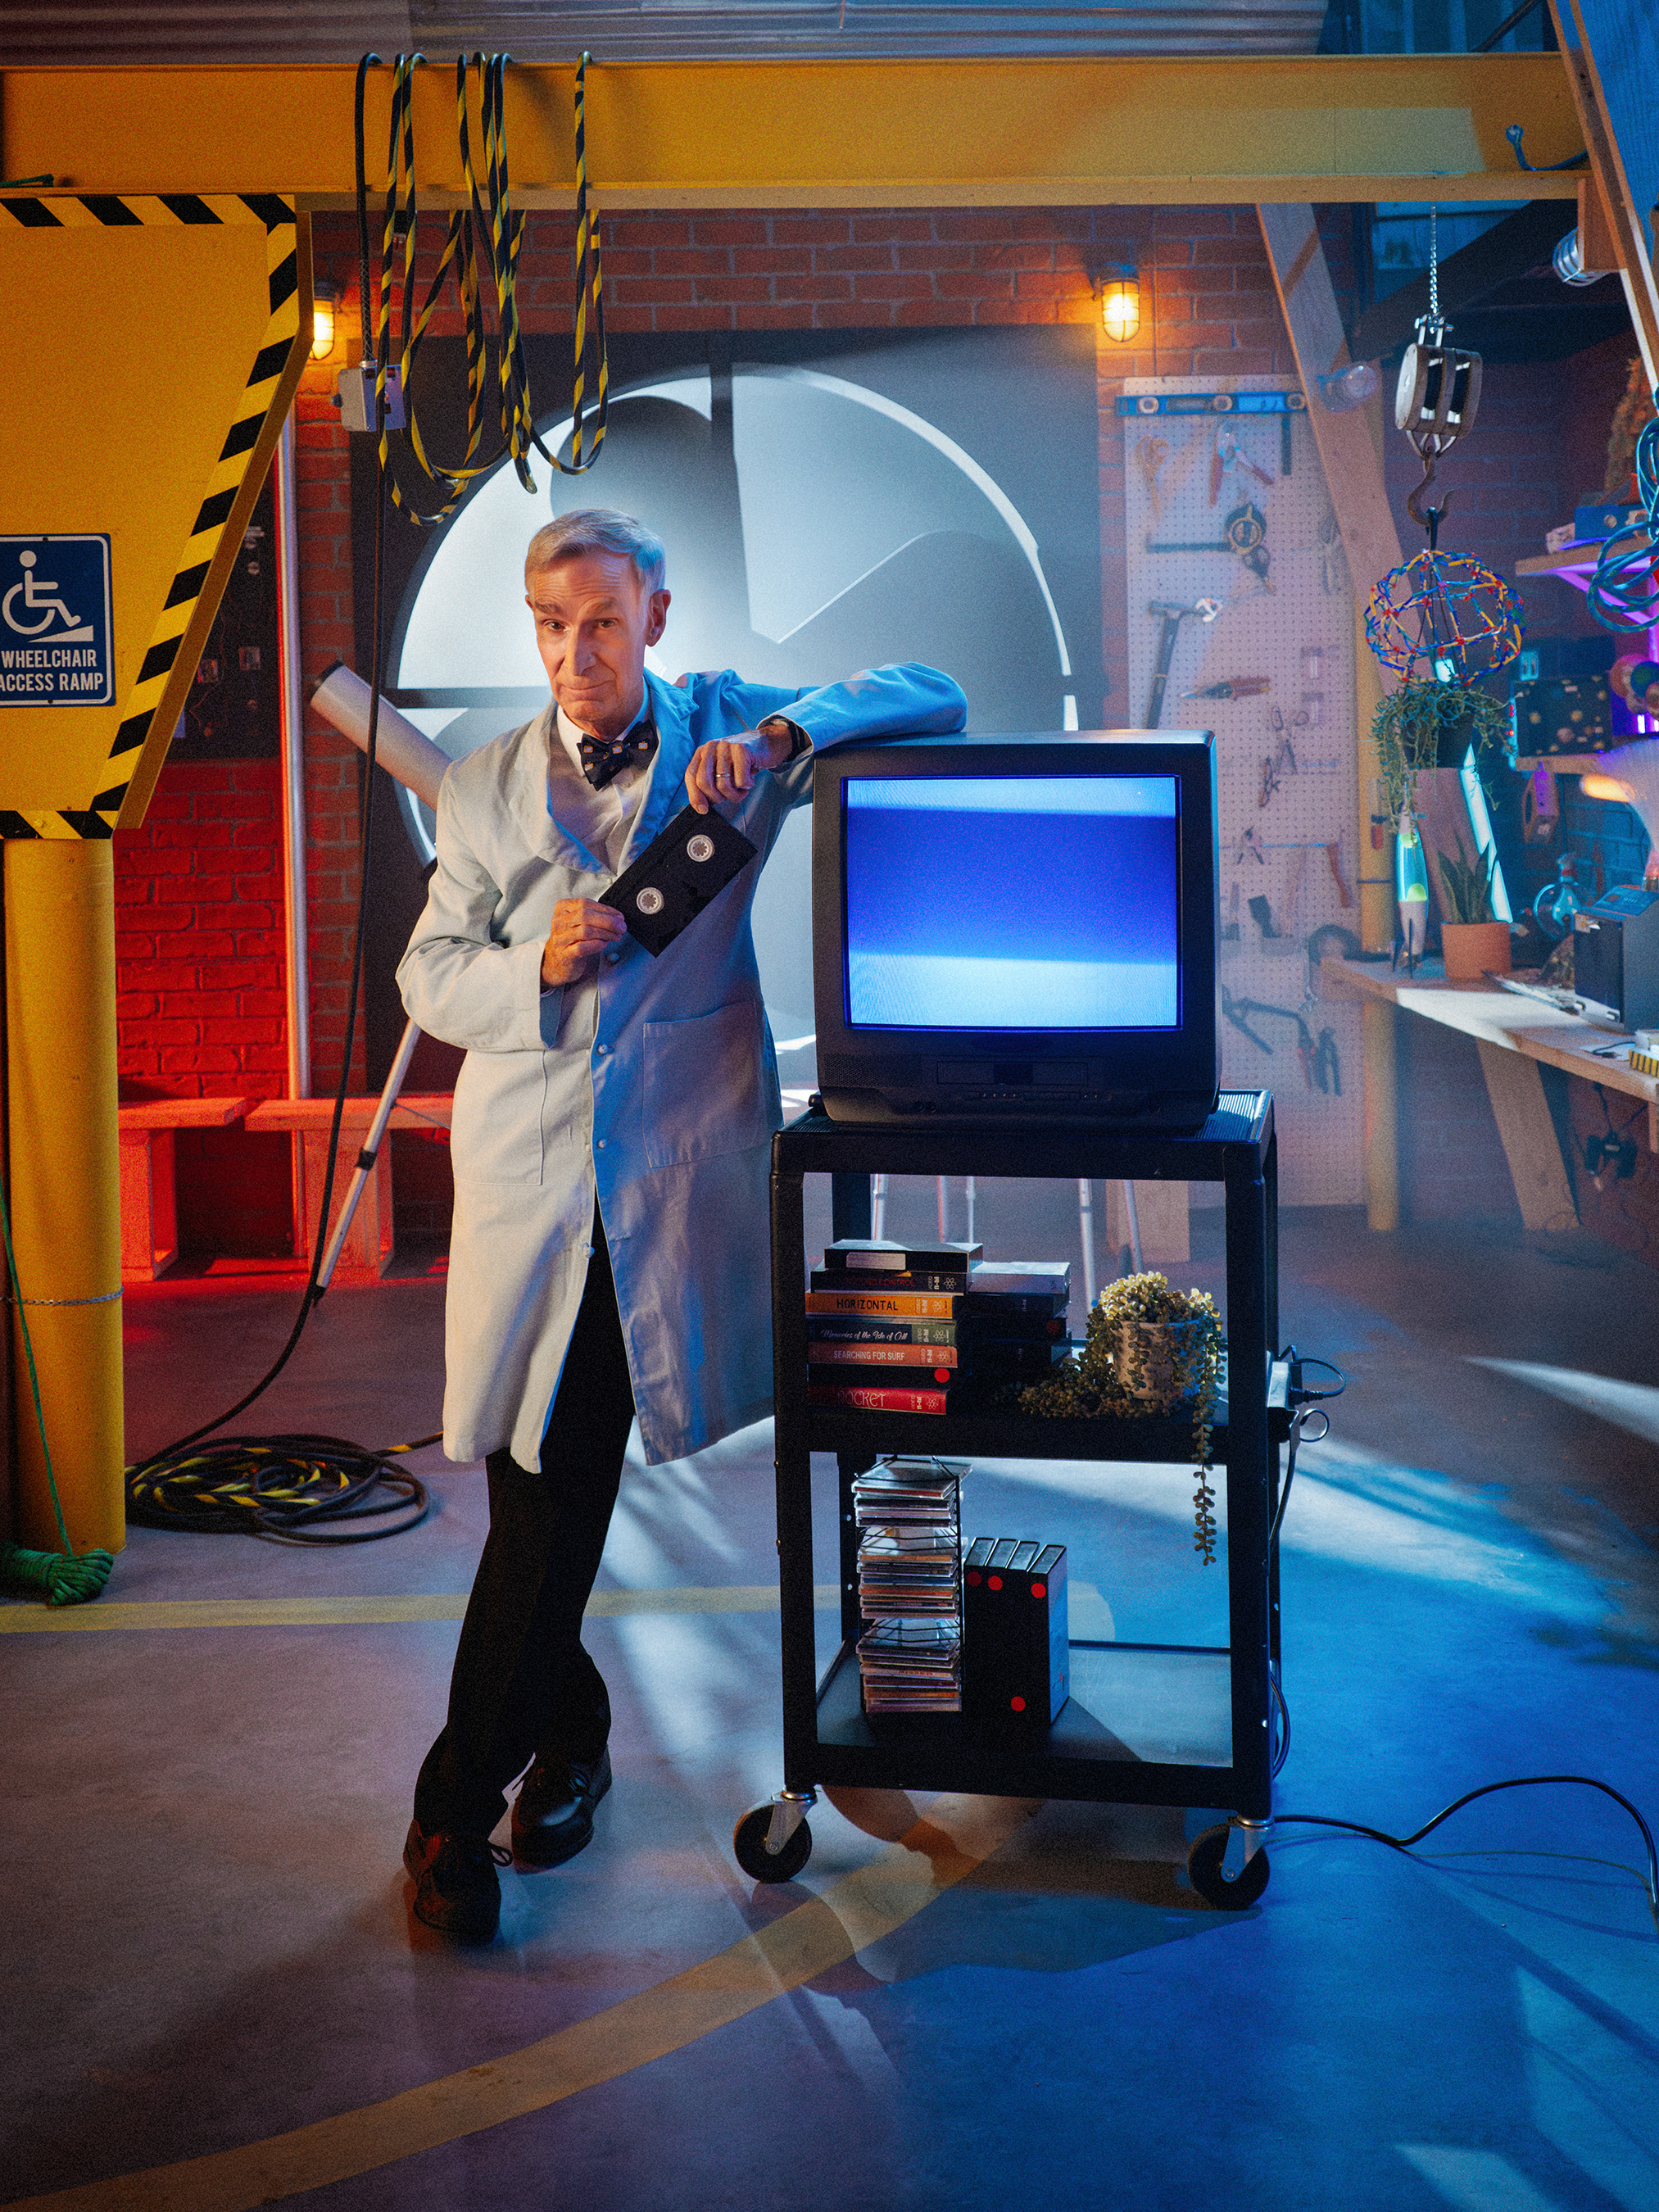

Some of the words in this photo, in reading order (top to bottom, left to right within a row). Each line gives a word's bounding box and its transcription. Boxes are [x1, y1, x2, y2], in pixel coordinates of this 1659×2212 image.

[1, 649, 97, 669] WHEELCHAIR
[0, 673, 54, 692] ACCESS
[59, 673, 104, 691] RAMP
[878, 1278, 917, 1287] CONTROL
[836, 1298, 898, 1311] HORIZONTAL
[854, 1330, 861, 1340] of
[861, 1330, 871, 1339] the
[886, 1331, 894, 1341] of
[833, 1350, 871, 1360] SEARCHING
[873, 1351, 886, 1361] FOR
[887, 1352, 905, 1361] SURF
